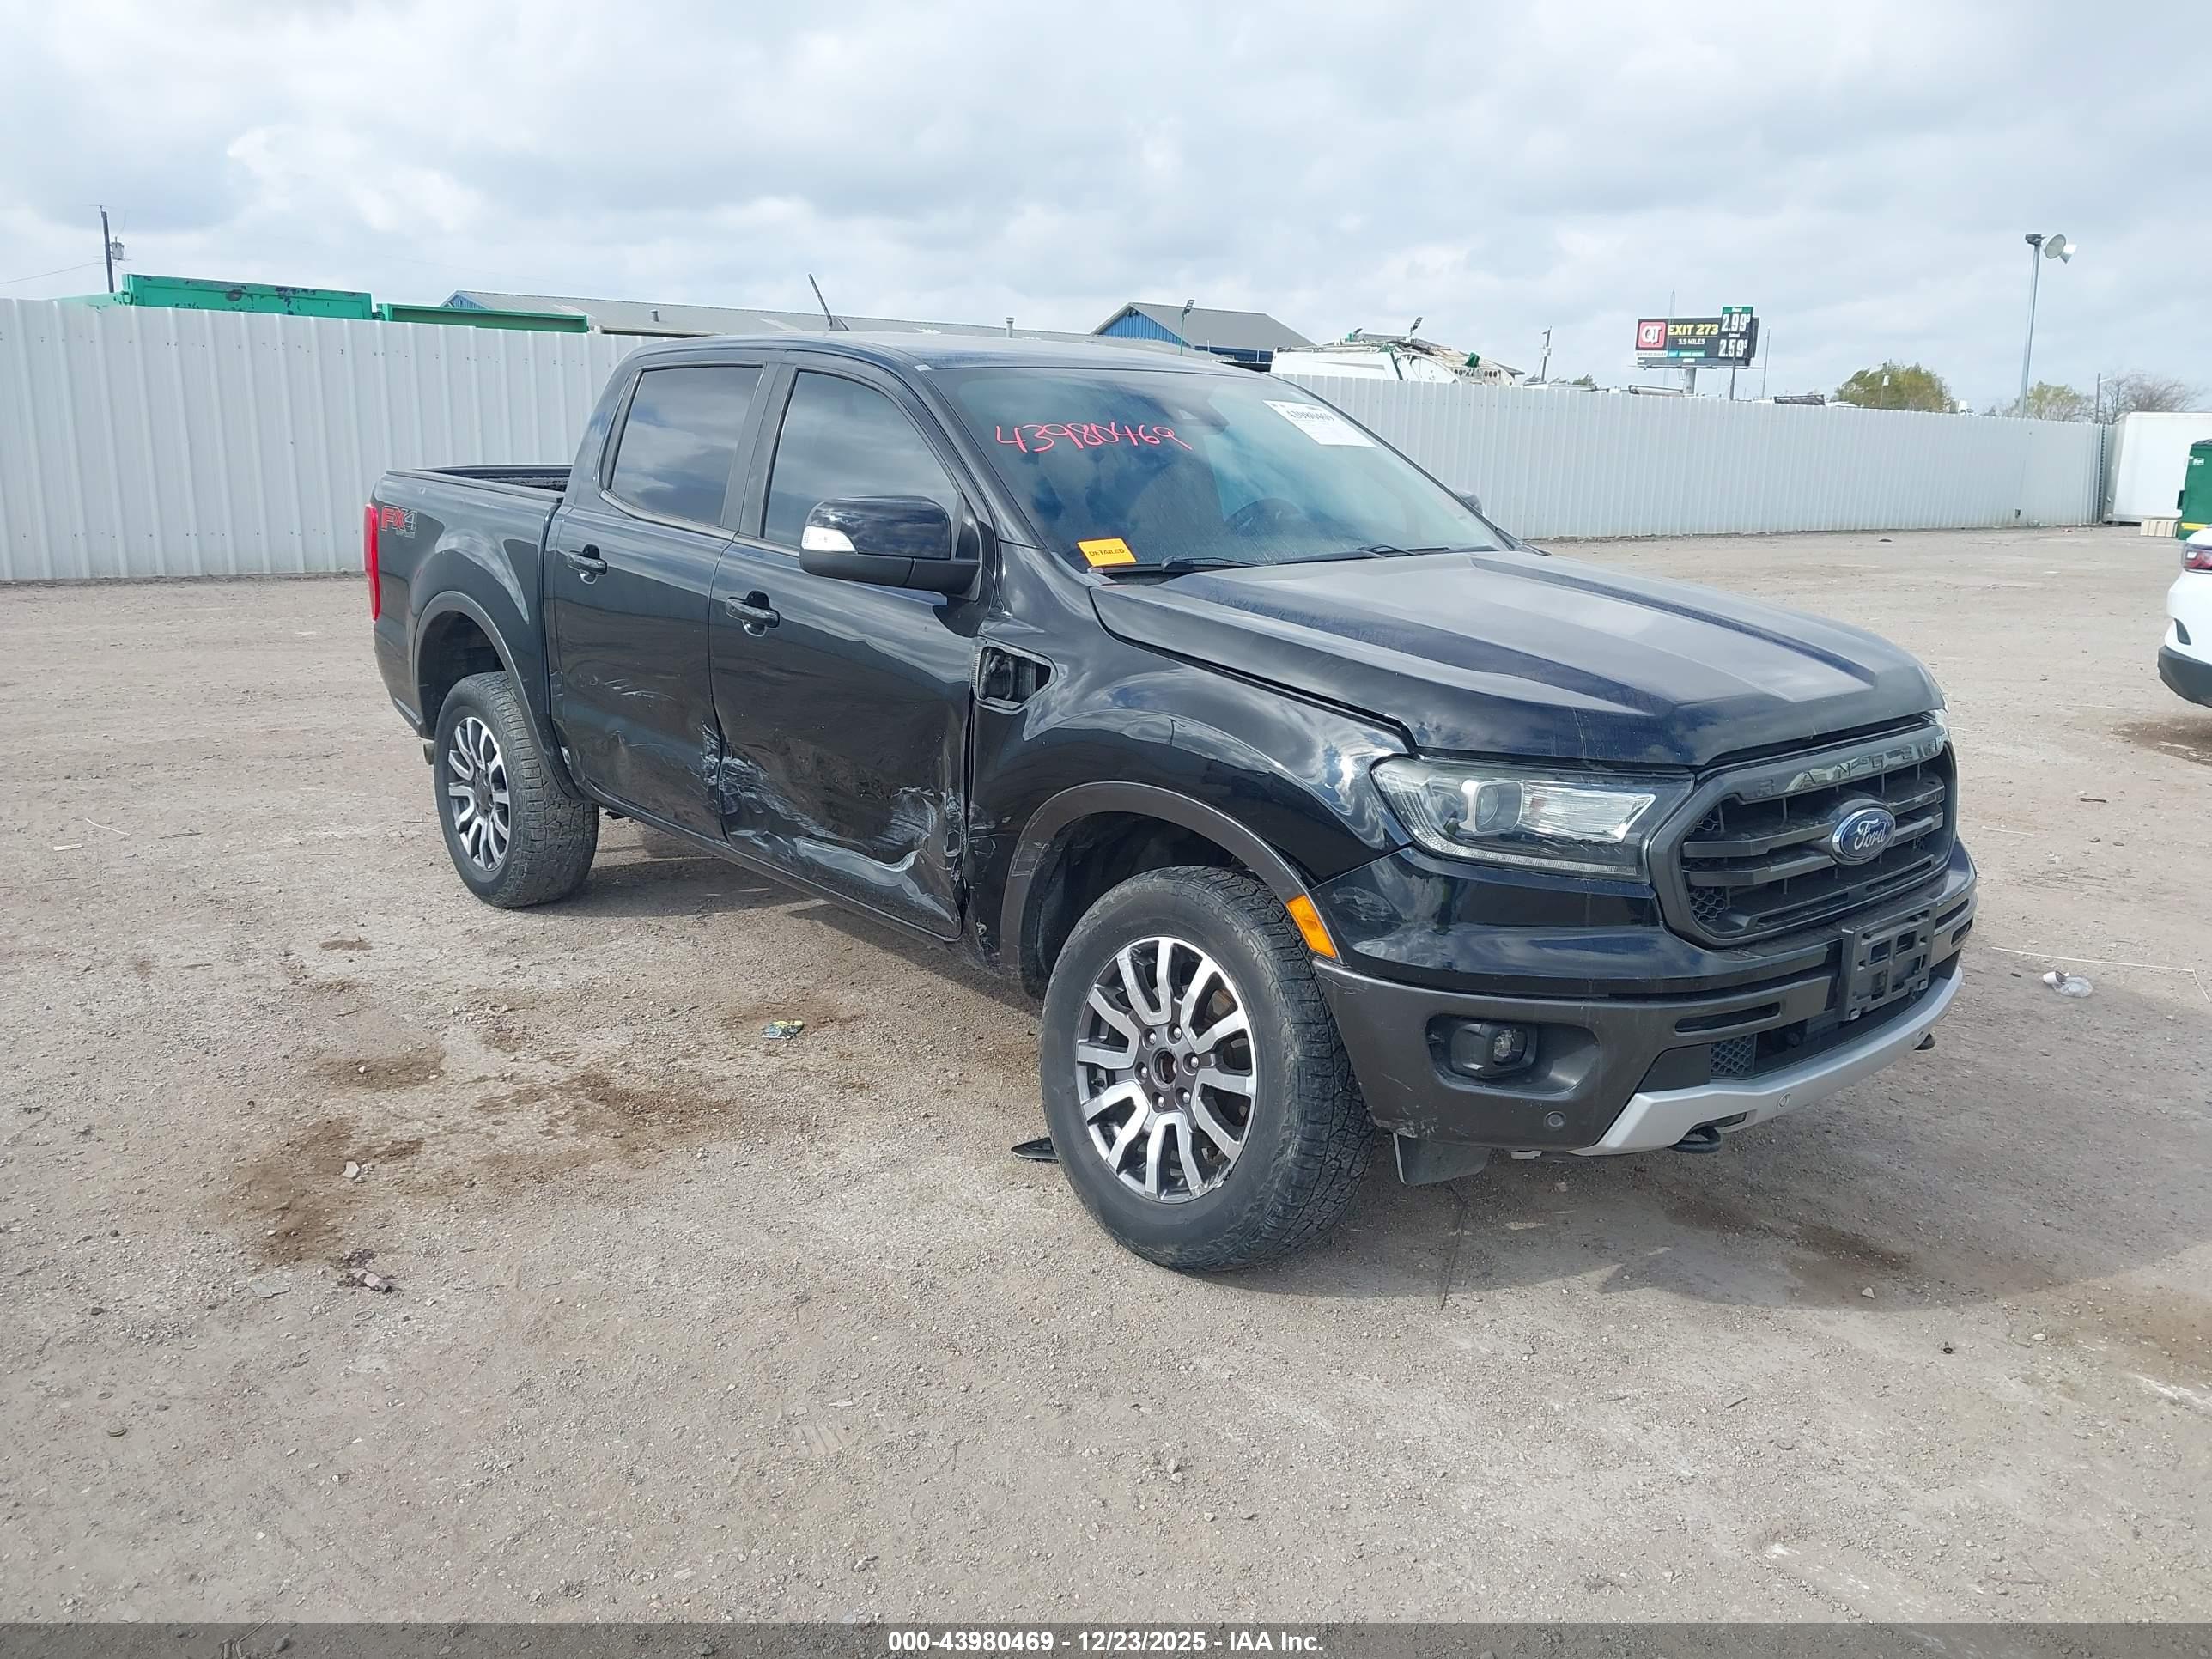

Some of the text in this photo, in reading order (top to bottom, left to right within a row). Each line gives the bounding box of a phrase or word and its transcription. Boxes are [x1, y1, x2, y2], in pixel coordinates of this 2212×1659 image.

[1642, 325, 1662, 344] QT
[1668, 324, 1718, 336] EXIT 273
[996, 422, 1193, 453] 43980469
[381, 505, 418, 532] FX4
[1088, 548, 1125, 556] DETAILED
[1853, 818, 1888, 851] Ford
